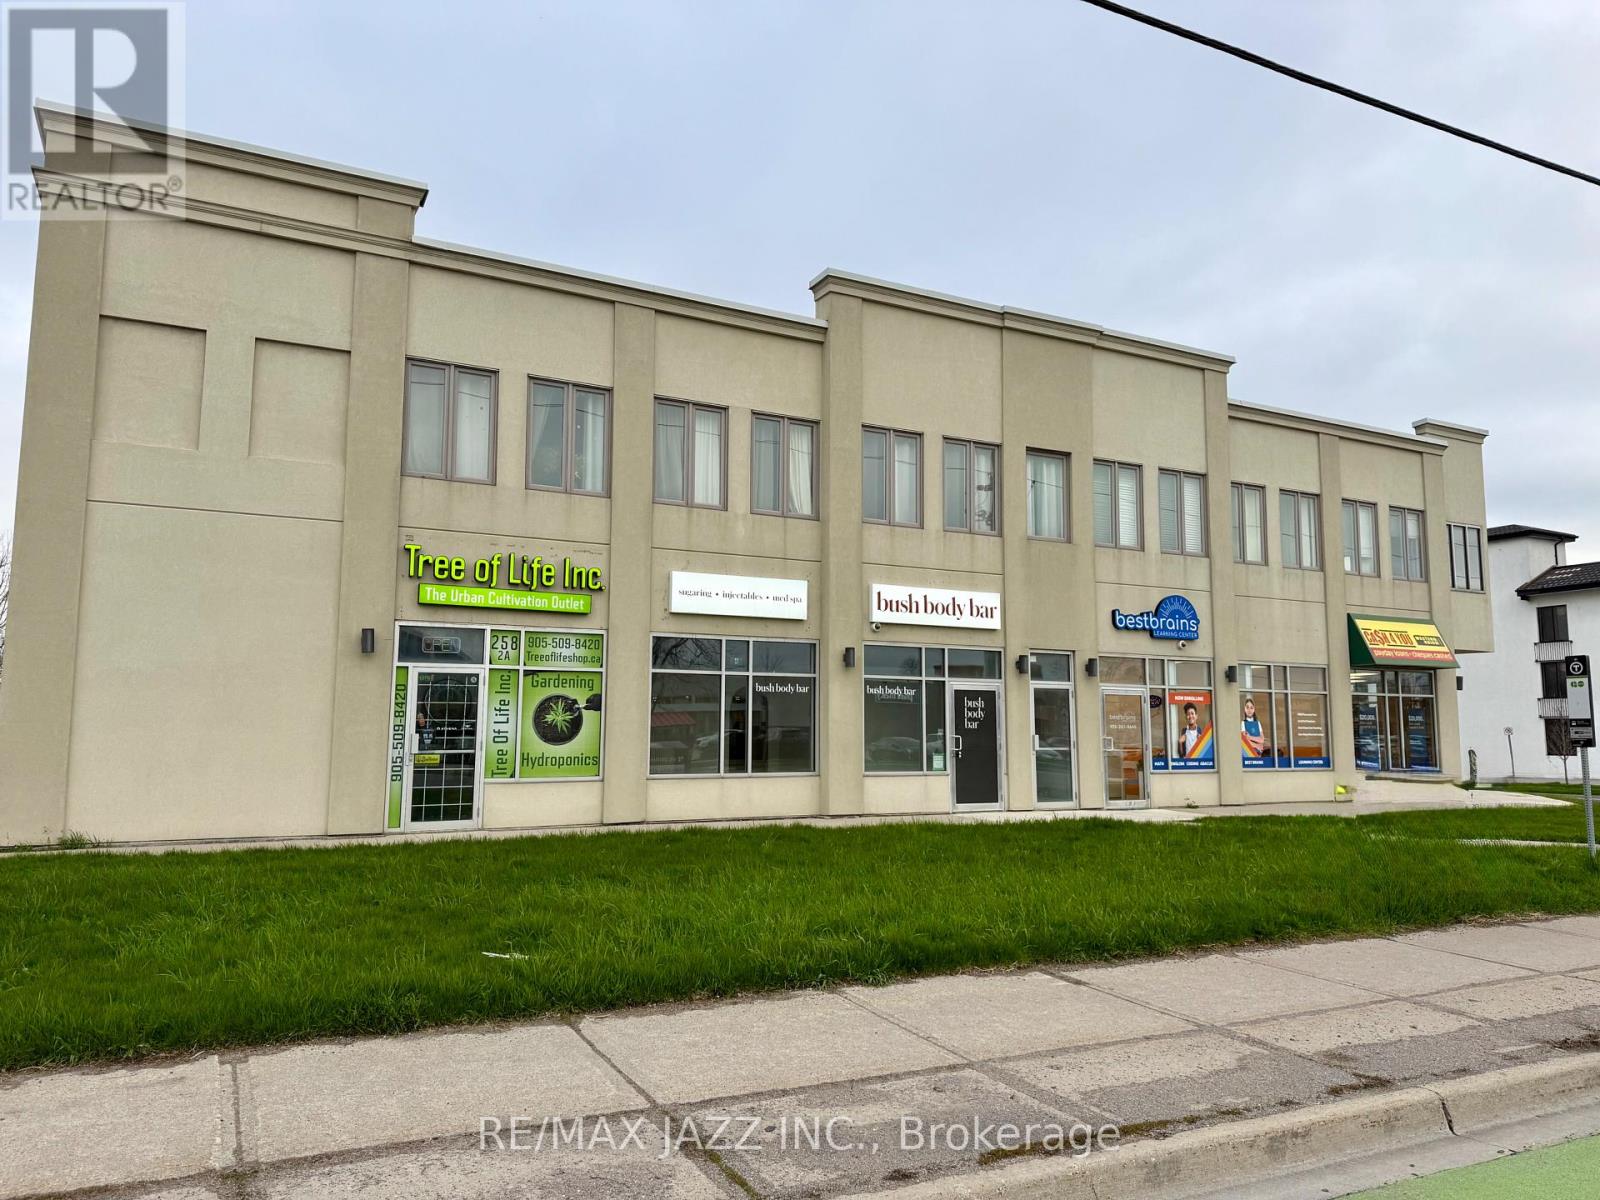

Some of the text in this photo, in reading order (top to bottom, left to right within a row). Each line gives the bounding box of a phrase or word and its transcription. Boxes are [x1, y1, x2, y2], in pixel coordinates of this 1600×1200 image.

[404, 543, 607, 592] Tree of Life Inc.
[425, 587, 584, 610] The Urban Cultivation Outlet
[678, 588, 802, 604] sugaring injectables med spa
[877, 591, 998, 620] bush body bar
[1115, 610, 1198, 632] bestbrains
[491, 634, 518, 651] 258
[527, 636, 600, 651] 905-509-8420
[497, 651, 511, 661] 2A
[527, 650, 601, 664] Treeoflifeshop.ca
[531, 673, 595, 692] Gardening
[755, 682, 810, 695] bush body bar
[866, 684, 884, 695] bush
[885, 685, 902, 697] body
[903, 686, 917, 696] bar
[964, 696, 985, 708] bush
[964, 707, 986, 720] body
[490, 670, 512, 778] Tree Of Life Inc.
[964, 719, 979, 729] bar
[391, 683, 407, 782] 905-509-8420
[521, 752, 598, 769] Hydroponics
